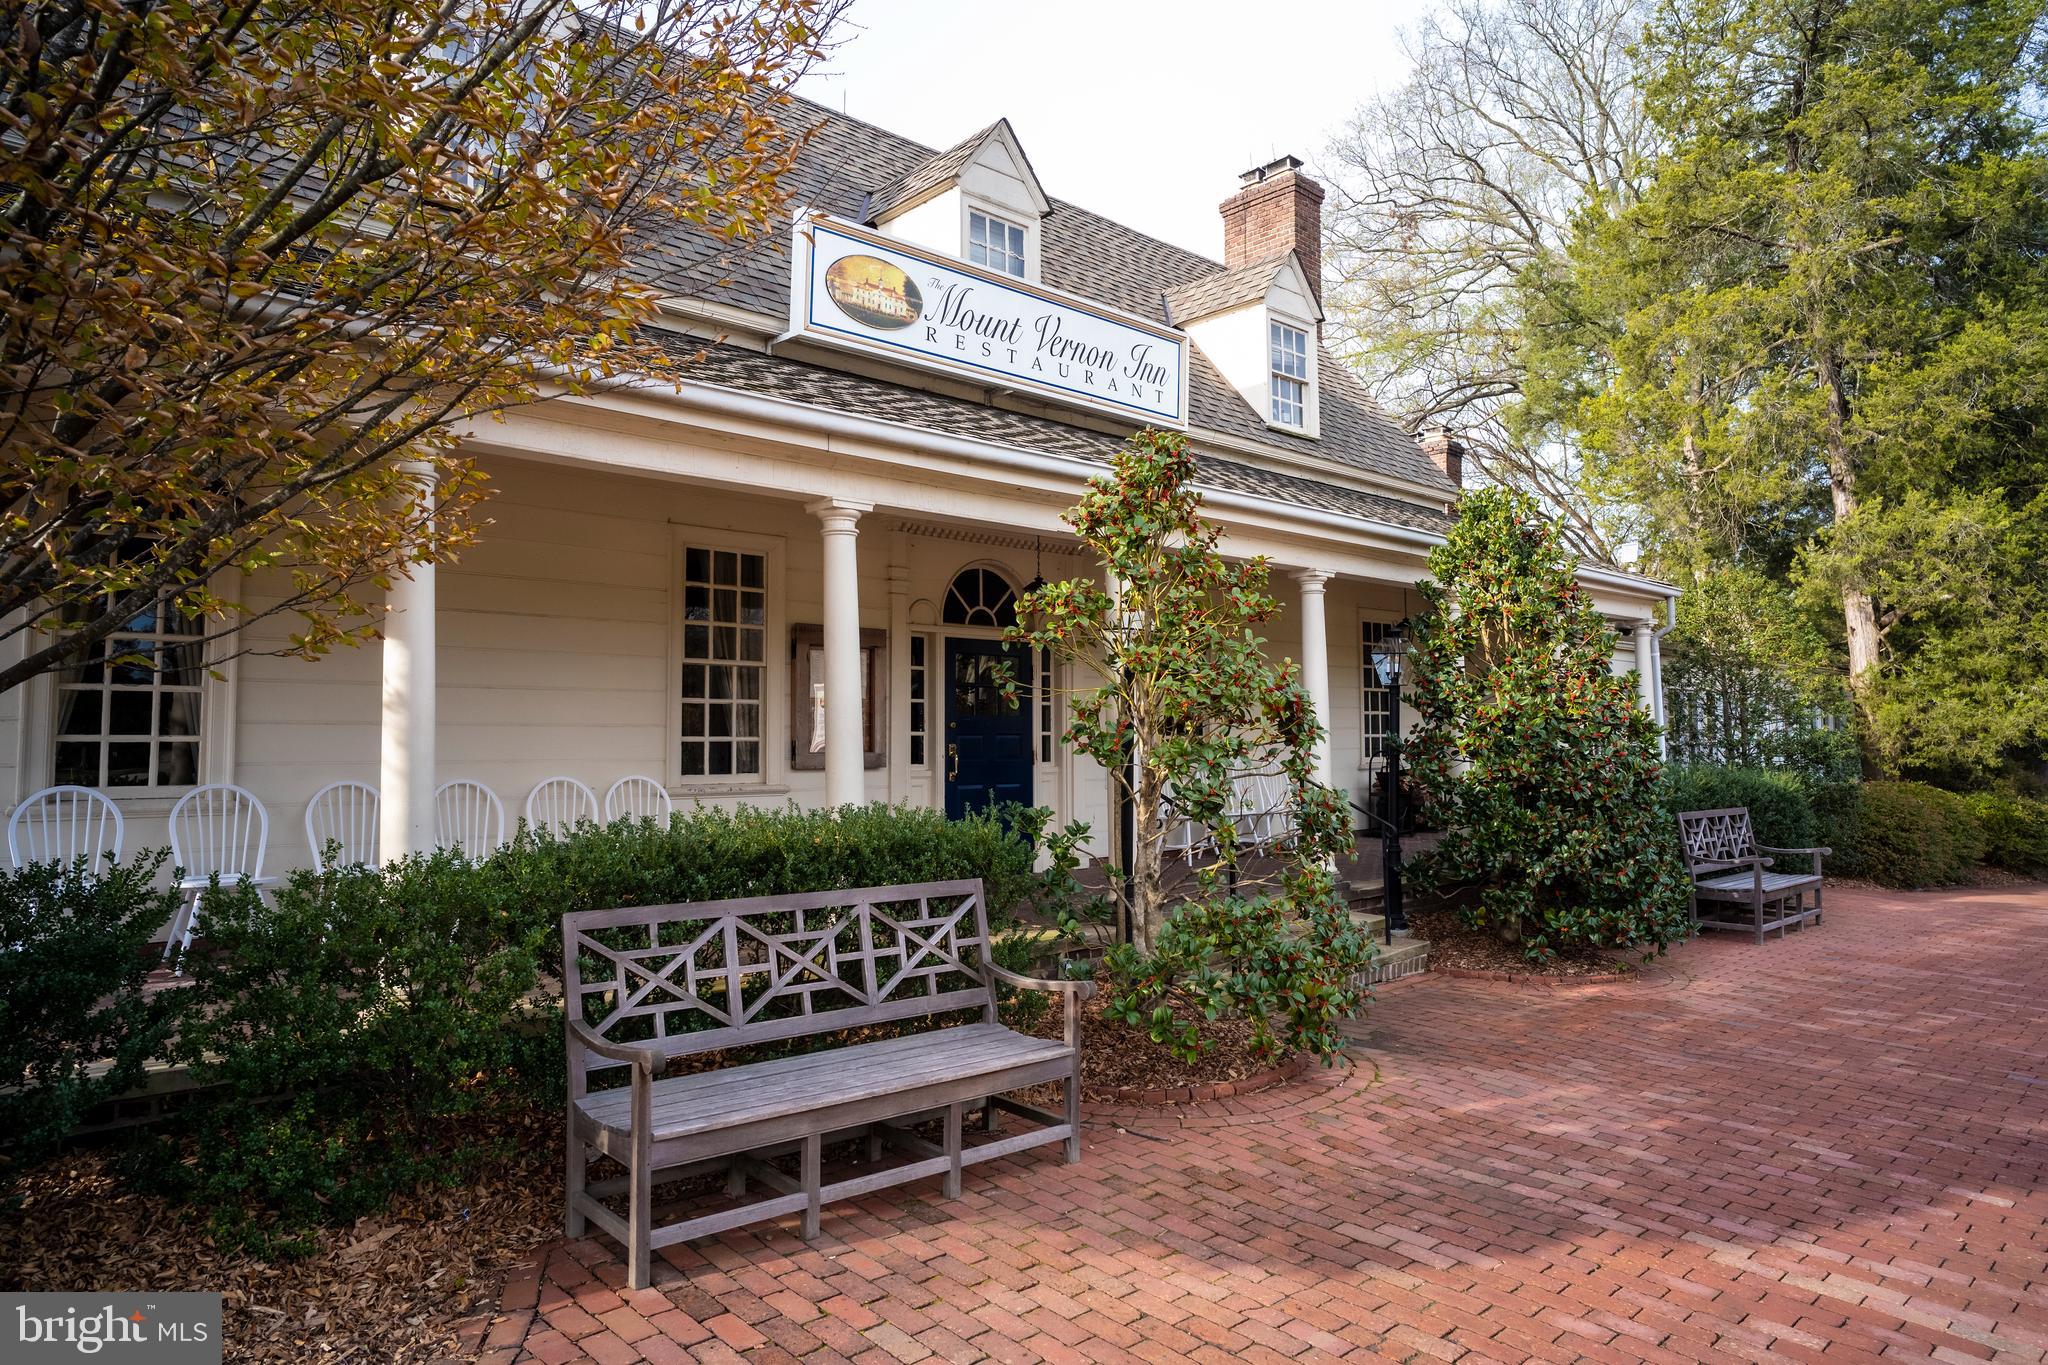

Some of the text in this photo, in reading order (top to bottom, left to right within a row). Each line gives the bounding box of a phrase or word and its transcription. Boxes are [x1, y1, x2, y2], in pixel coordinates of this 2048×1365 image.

[925, 277, 1168, 387] The Mount Vernon Inn
[926, 327, 1164, 404] RESTAURANT
